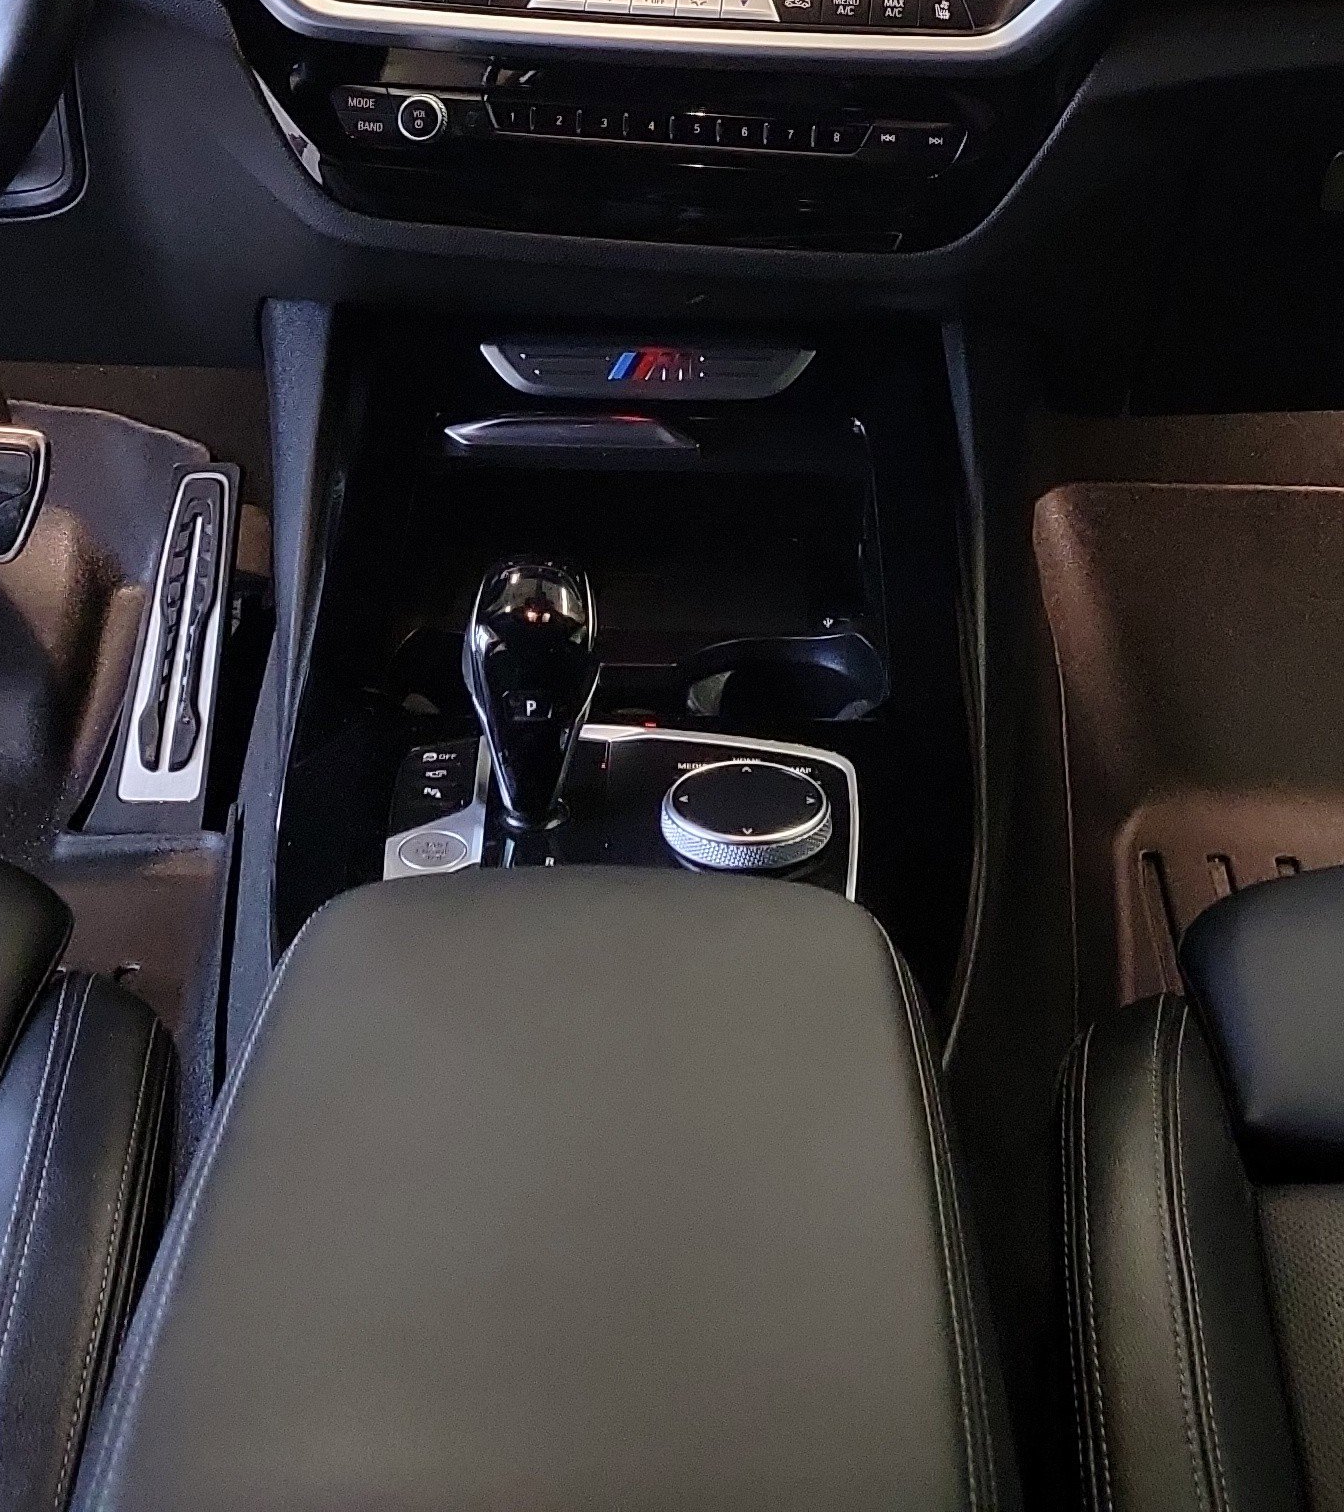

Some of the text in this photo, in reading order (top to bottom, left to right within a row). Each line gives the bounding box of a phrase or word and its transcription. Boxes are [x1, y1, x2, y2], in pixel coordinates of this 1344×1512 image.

[837, 5, 855, 16] A/C
[885, 7, 904, 18] A/C
[348, 96, 375, 109] MODE
[510, 112, 515, 123] 1
[556, 115, 563, 126] 2
[601, 118, 608, 128] 3
[357, 120, 384, 133] BAND
[648, 121, 655, 131] 4
[694, 123, 701, 134] 5
[741, 126, 748, 137] 6
[787, 129, 794, 140] 7
[833, 132, 841, 143] 8
[525, 700, 537, 717] P
[677, 762, 708, 770] MEDI
